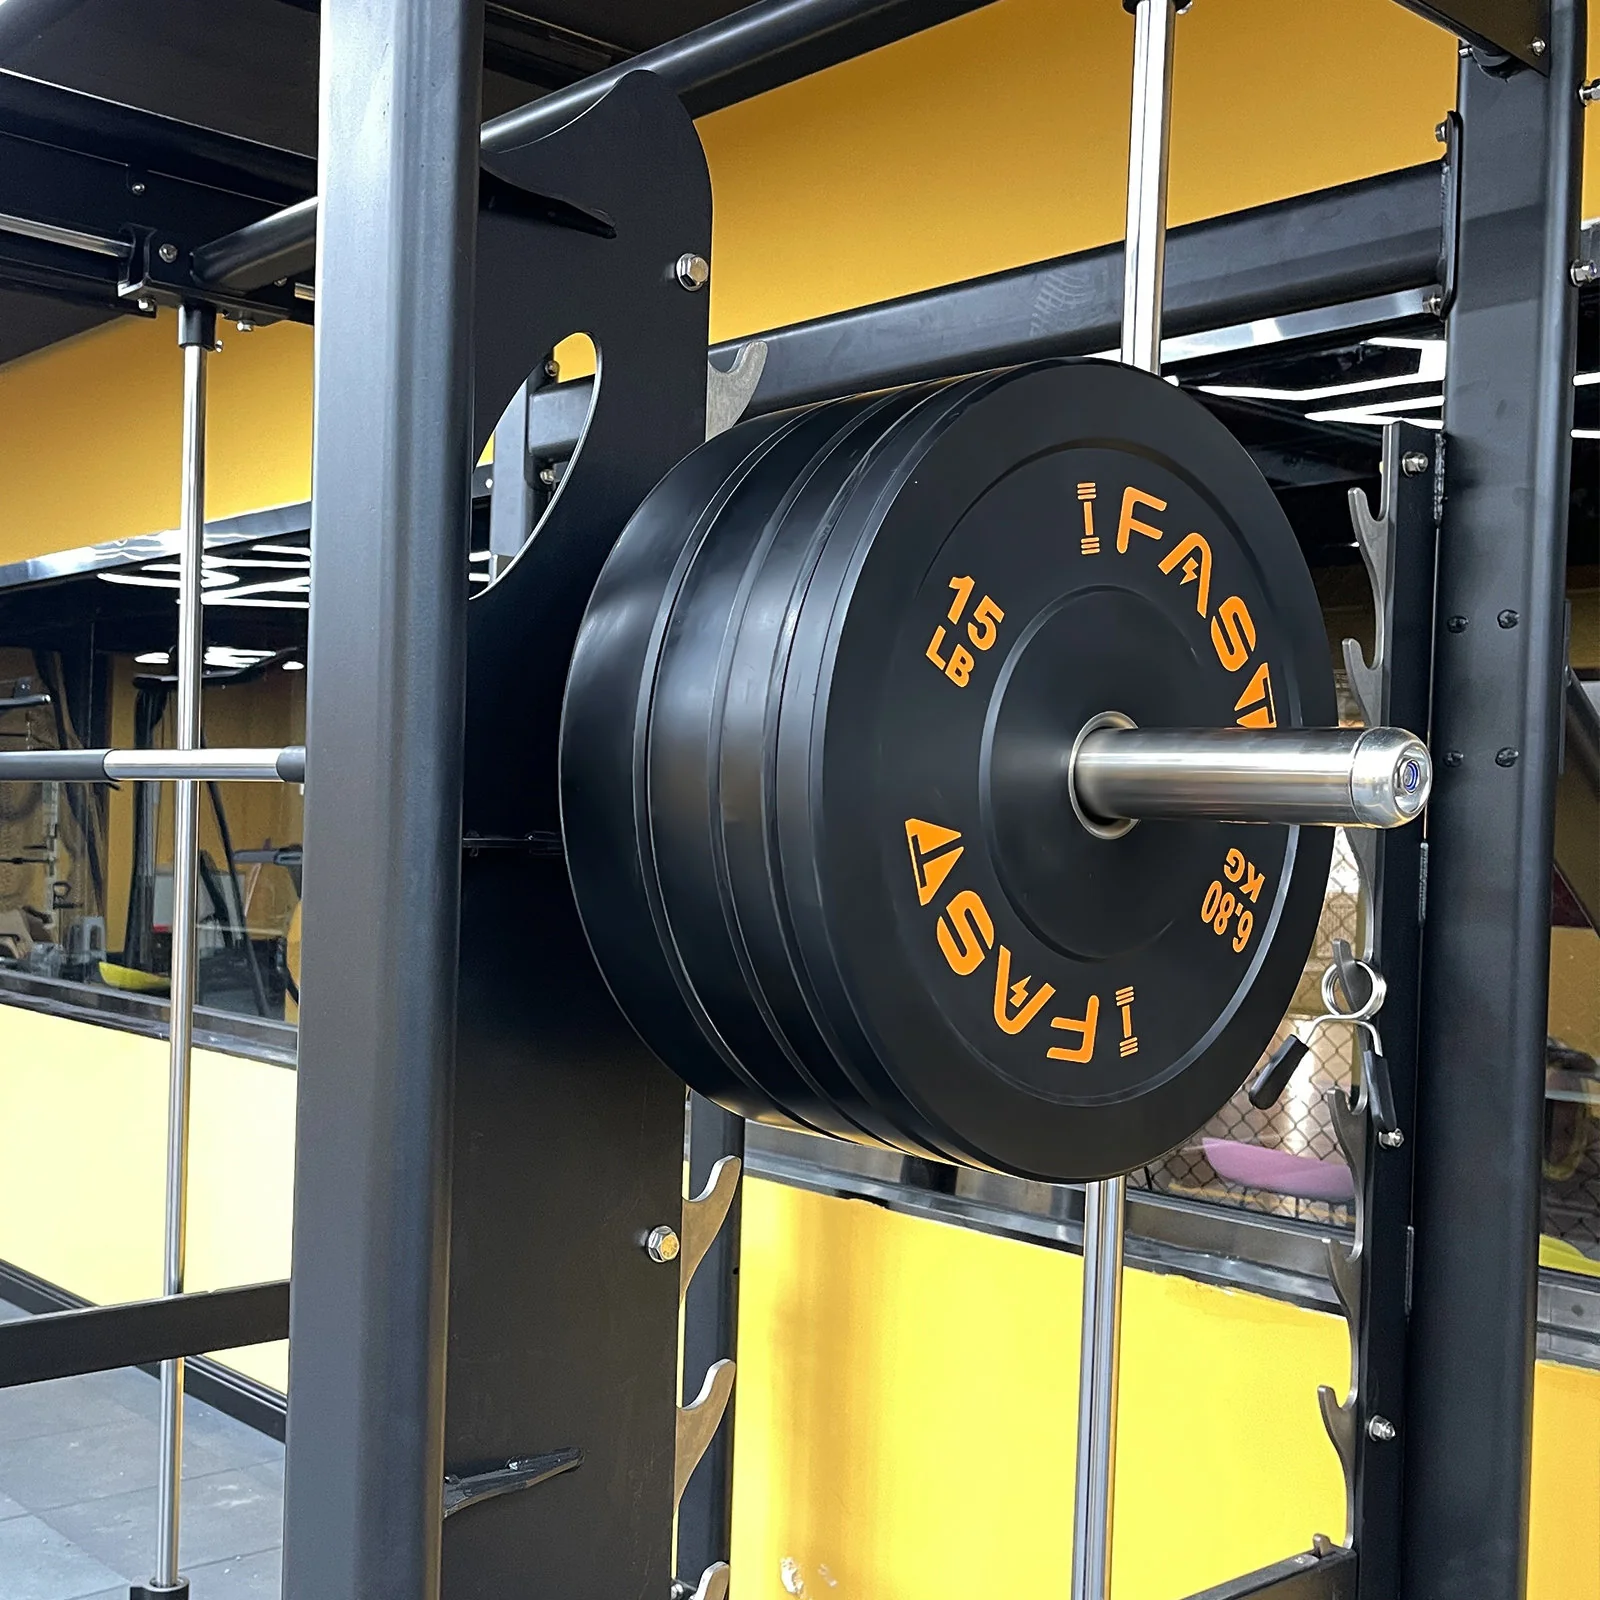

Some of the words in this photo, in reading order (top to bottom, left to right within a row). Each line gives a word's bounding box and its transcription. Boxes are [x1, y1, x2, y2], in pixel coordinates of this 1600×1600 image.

[948, 575, 1005, 651] 15
[926, 627, 975, 688] LB
[1223, 847, 1265, 902] KG
[1200, 880, 1255, 954] 6.80
